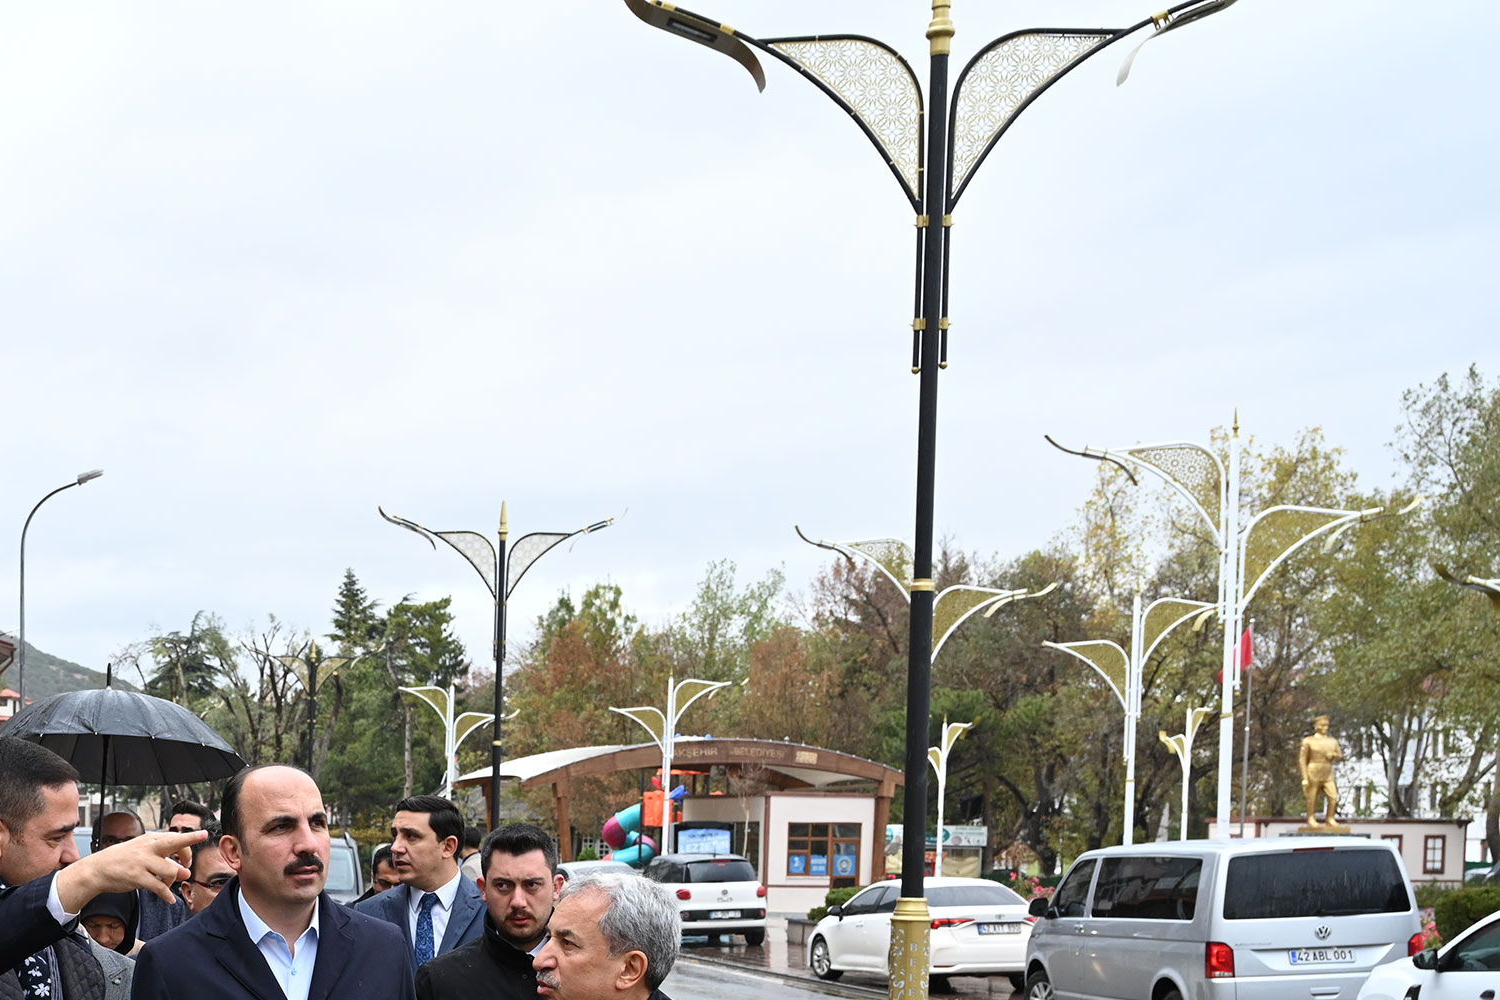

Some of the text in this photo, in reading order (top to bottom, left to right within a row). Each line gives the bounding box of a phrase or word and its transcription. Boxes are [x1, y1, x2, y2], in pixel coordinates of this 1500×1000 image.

[1297, 949, 1353, 962] 42 ABL 001
